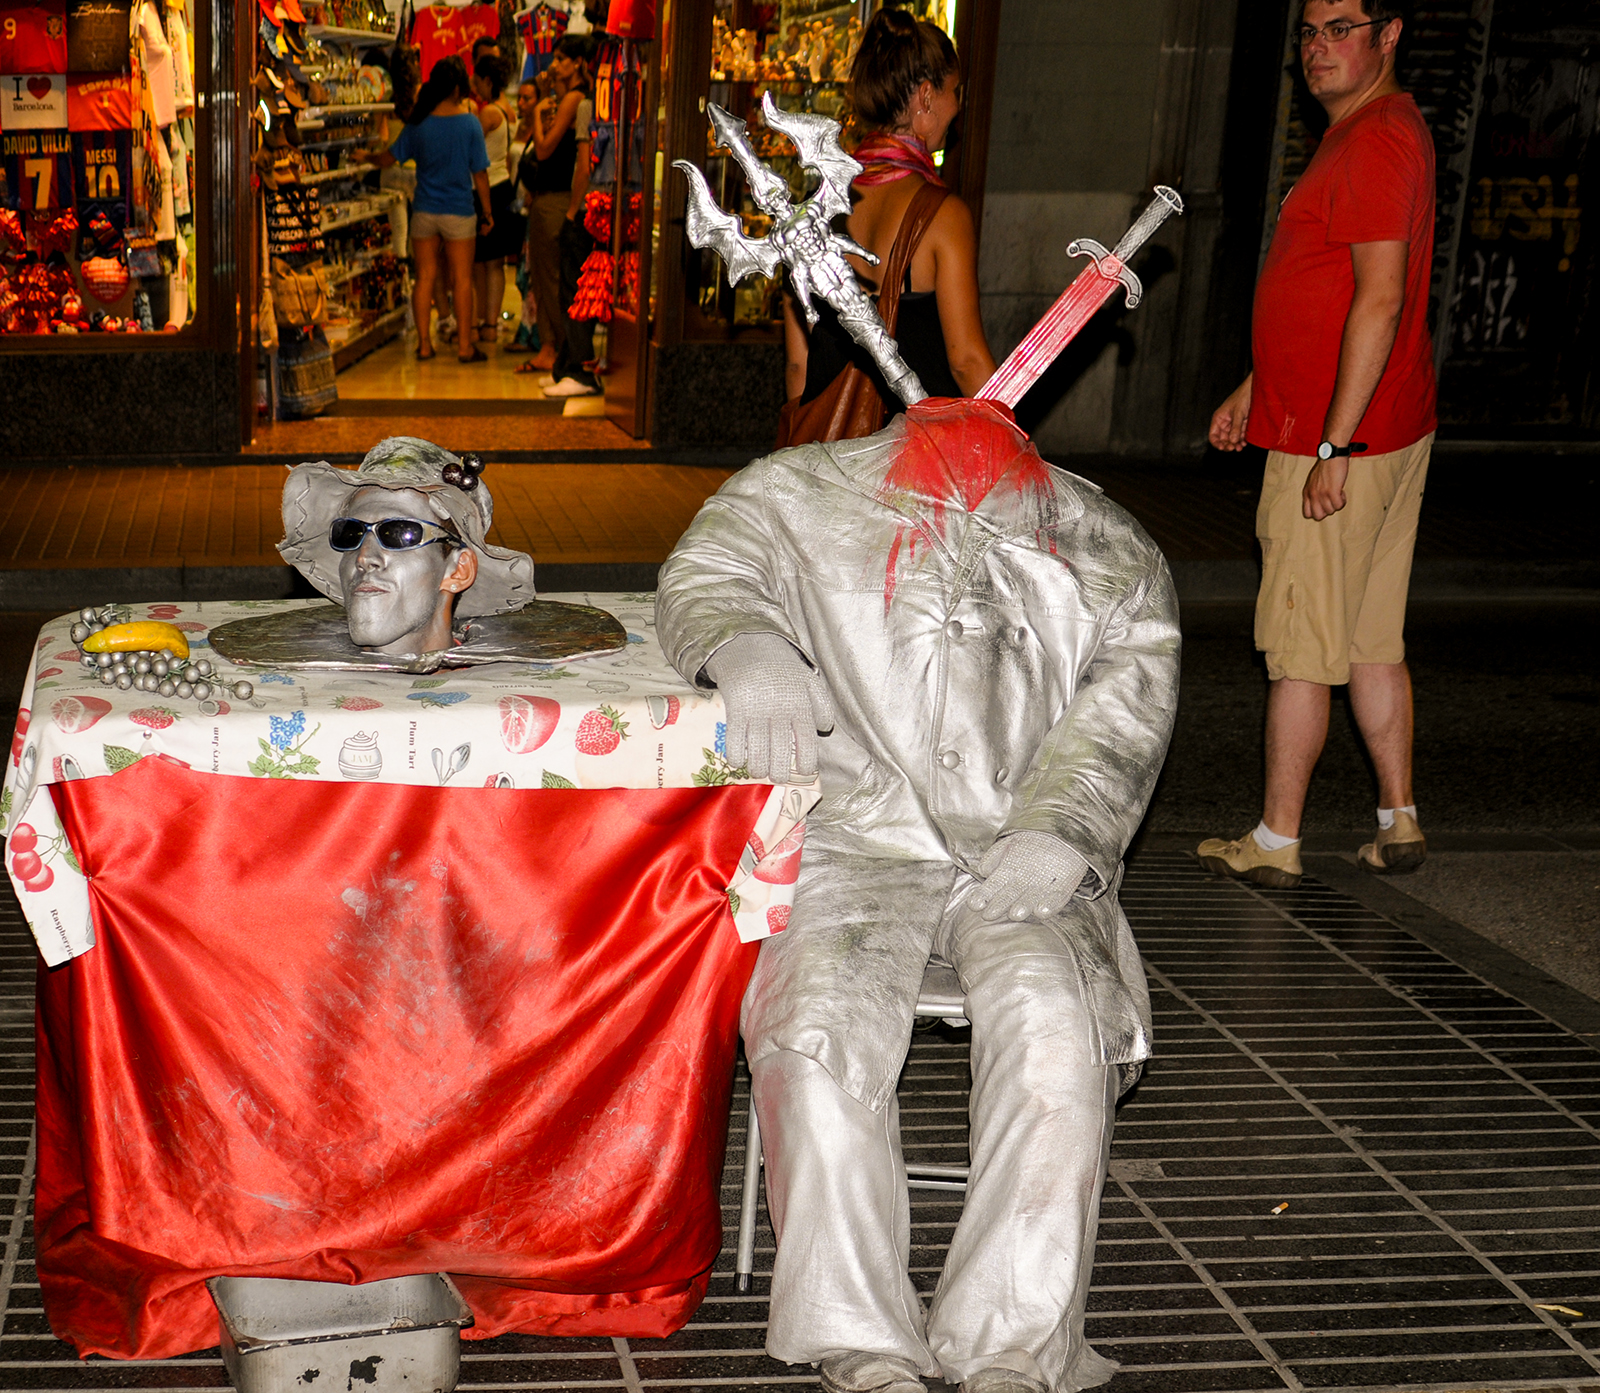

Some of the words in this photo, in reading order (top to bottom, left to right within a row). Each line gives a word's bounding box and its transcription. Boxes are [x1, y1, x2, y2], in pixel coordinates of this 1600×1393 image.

[4, 18, 17, 40] 9
[12, 76, 23, 101] I
[4, 135, 38, 155] DAVID
[41, 134, 72, 154] VILLA
[86, 149, 117, 164] MESSI
[25, 158, 52, 210] 7
[85, 165, 120, 198] 10
[211, 727, 219, 747] Jam
[409, 721, 417, 746] Plum
[211, 748, 221, 774] berry
[351, 754, 372, 763] JAM
[408, 748, 417, 769] Tart
[656, 743, 664, 763] Jam
[657, 765, 666, 789] erry
[50, 908, 74, 959] Raspberrie
